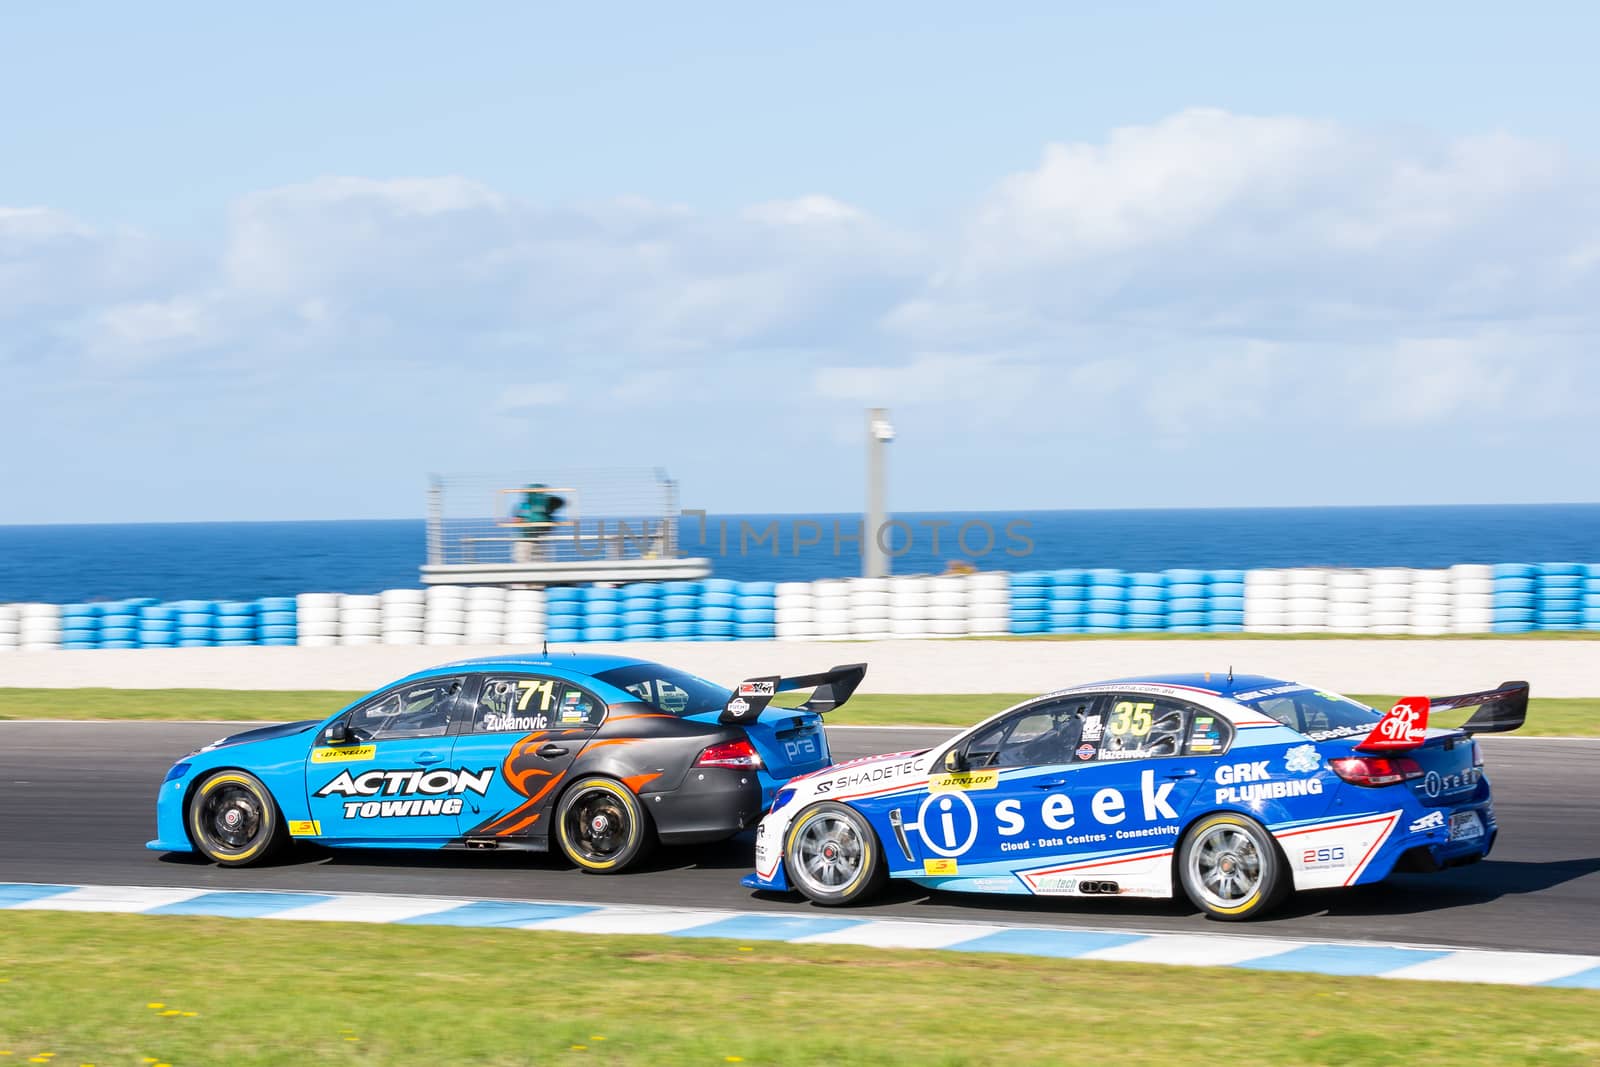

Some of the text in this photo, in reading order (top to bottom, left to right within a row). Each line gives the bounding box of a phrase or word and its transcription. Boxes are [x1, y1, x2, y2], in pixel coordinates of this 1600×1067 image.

[517, 680, 554, 710] 71
[487, 713, 548, 731] Zukanovic
[1109, 701, 1155, 736] 35
[785, 740, 815, 762] pra
[312, 768, 497, 797] ACTION
[836, 758, 924, 789] SHADETEC
[942, 776, 992, 786] DUNLOP
[1215, 761, 1271, 785] GRK
[1216, 779, 1323, 804] PLUMBING
[343, 799, 463, 819] TOWING
[1001, 825, 1180, 852] Cloud Data Centres Connectivity
[1303, 847, 1344, 862] 2SG
